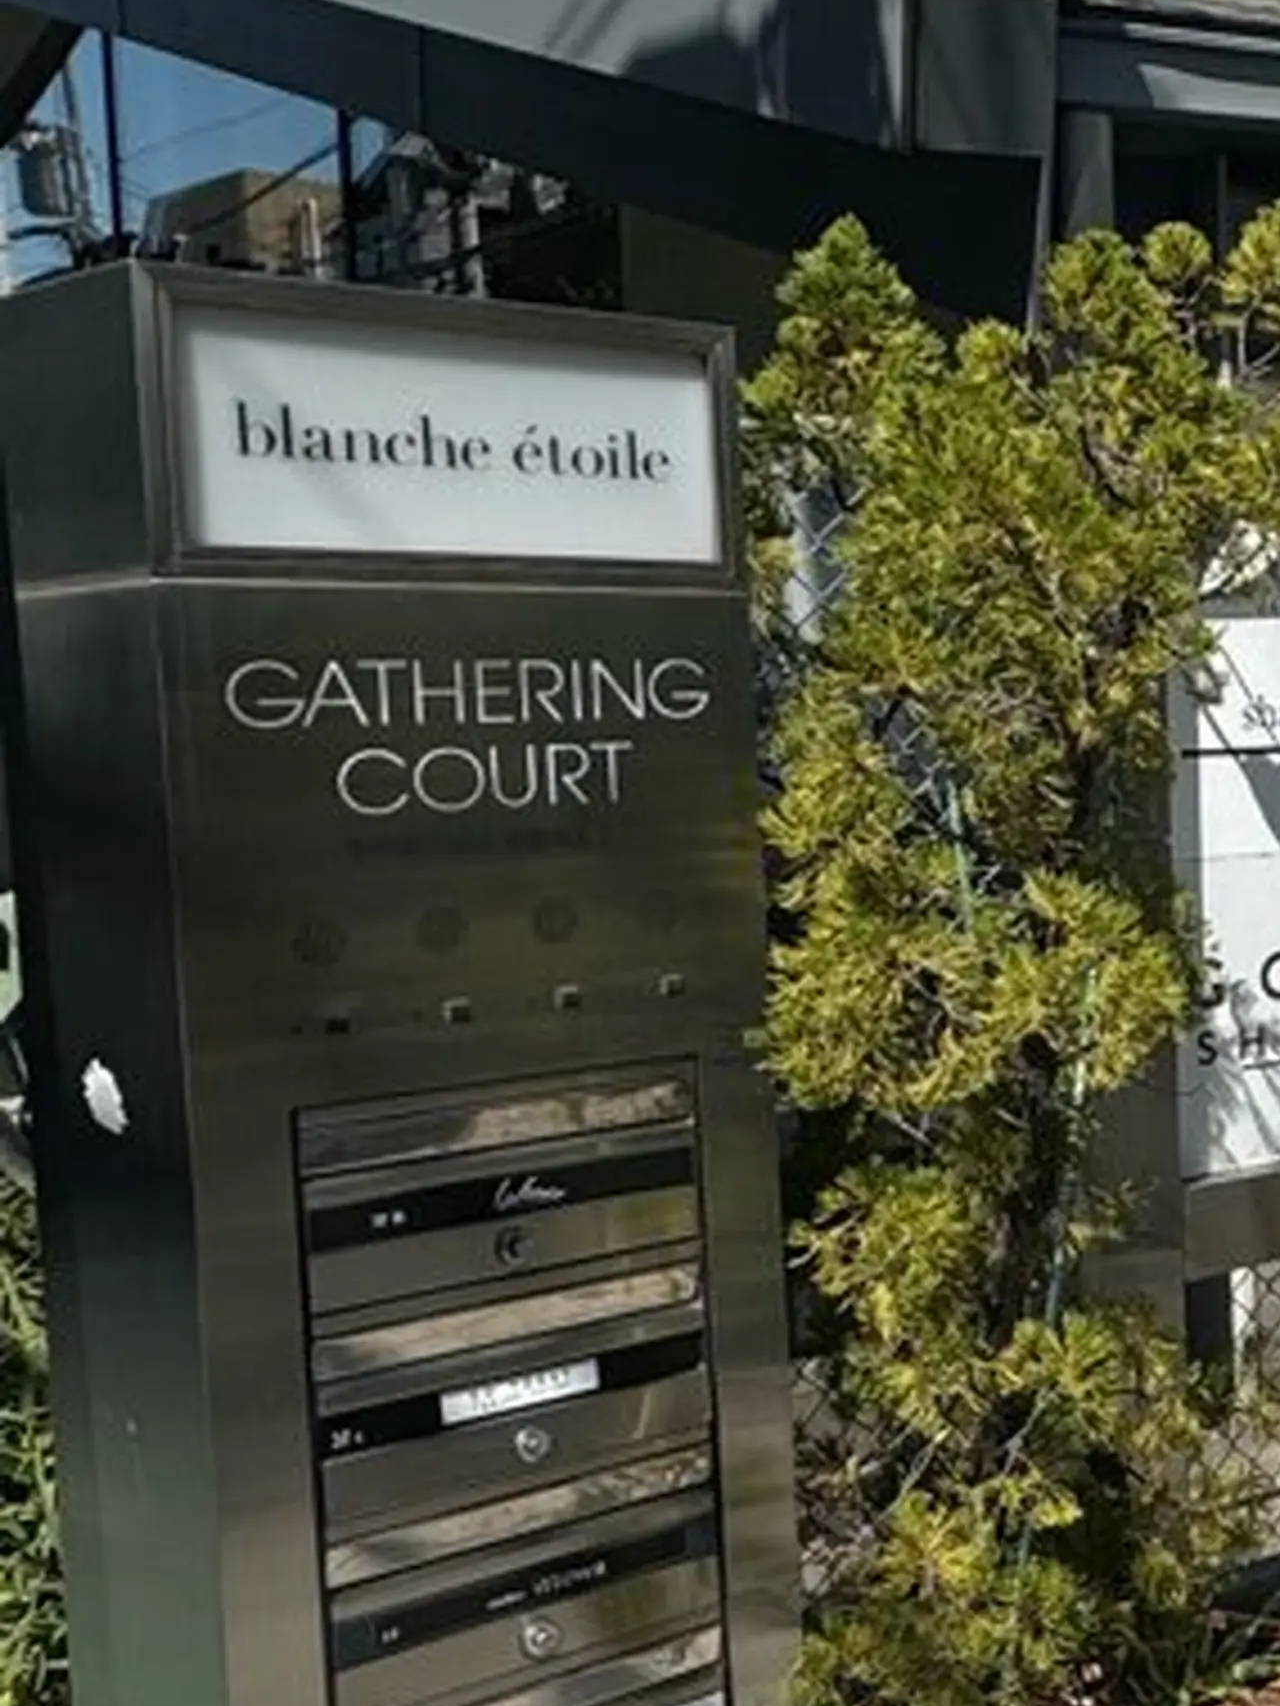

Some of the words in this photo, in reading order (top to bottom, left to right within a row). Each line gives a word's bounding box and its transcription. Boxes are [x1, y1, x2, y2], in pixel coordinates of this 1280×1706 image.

[235, 399, 491, 471] blanche
[512, 424, 671, 482] étoile
[224, 658, 710, 730] GATHERING
[336, 740, 634, 816] COURT
